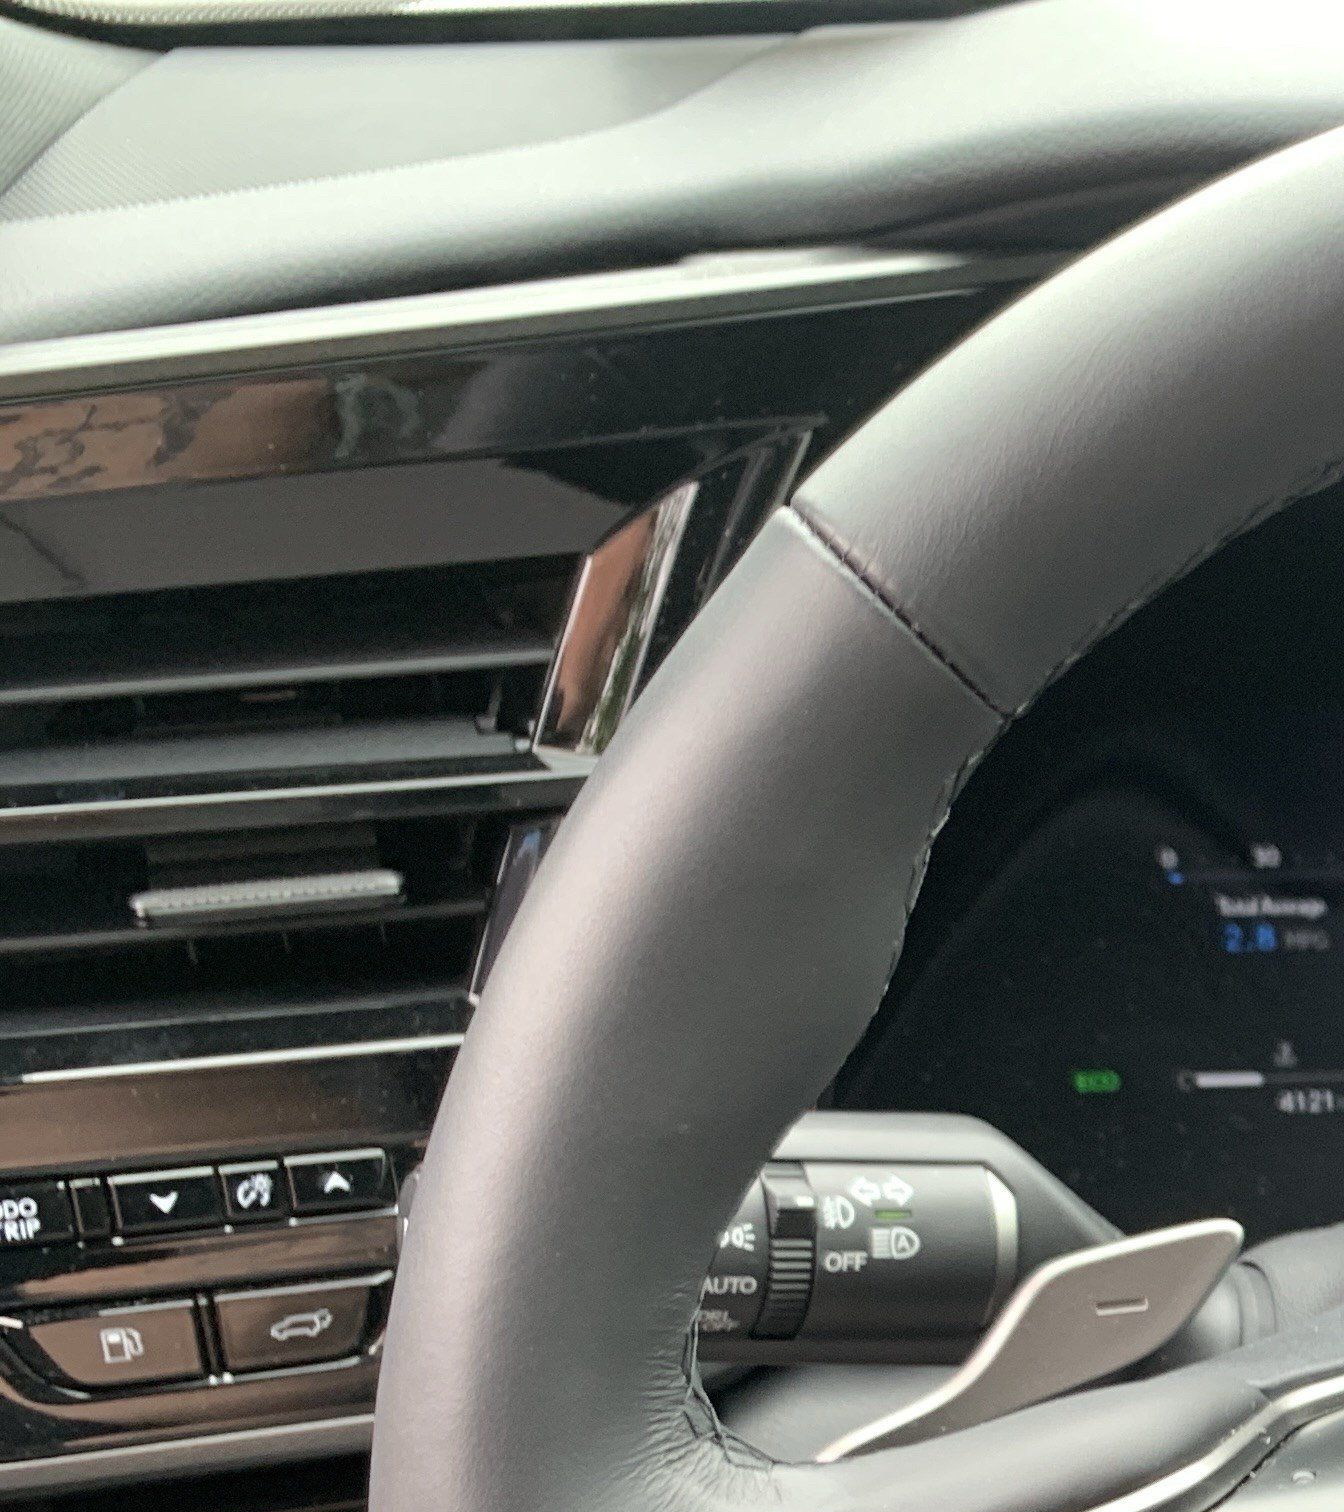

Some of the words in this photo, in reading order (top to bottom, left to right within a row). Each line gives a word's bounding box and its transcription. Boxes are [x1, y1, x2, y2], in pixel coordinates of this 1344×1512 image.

[0, 1196, 38, 1221] DO
[0, 1217, 41, 1242] RIP
[823, 1250, 868, 1274] OFF
[701, 1275, 758, 1296] AUTO
